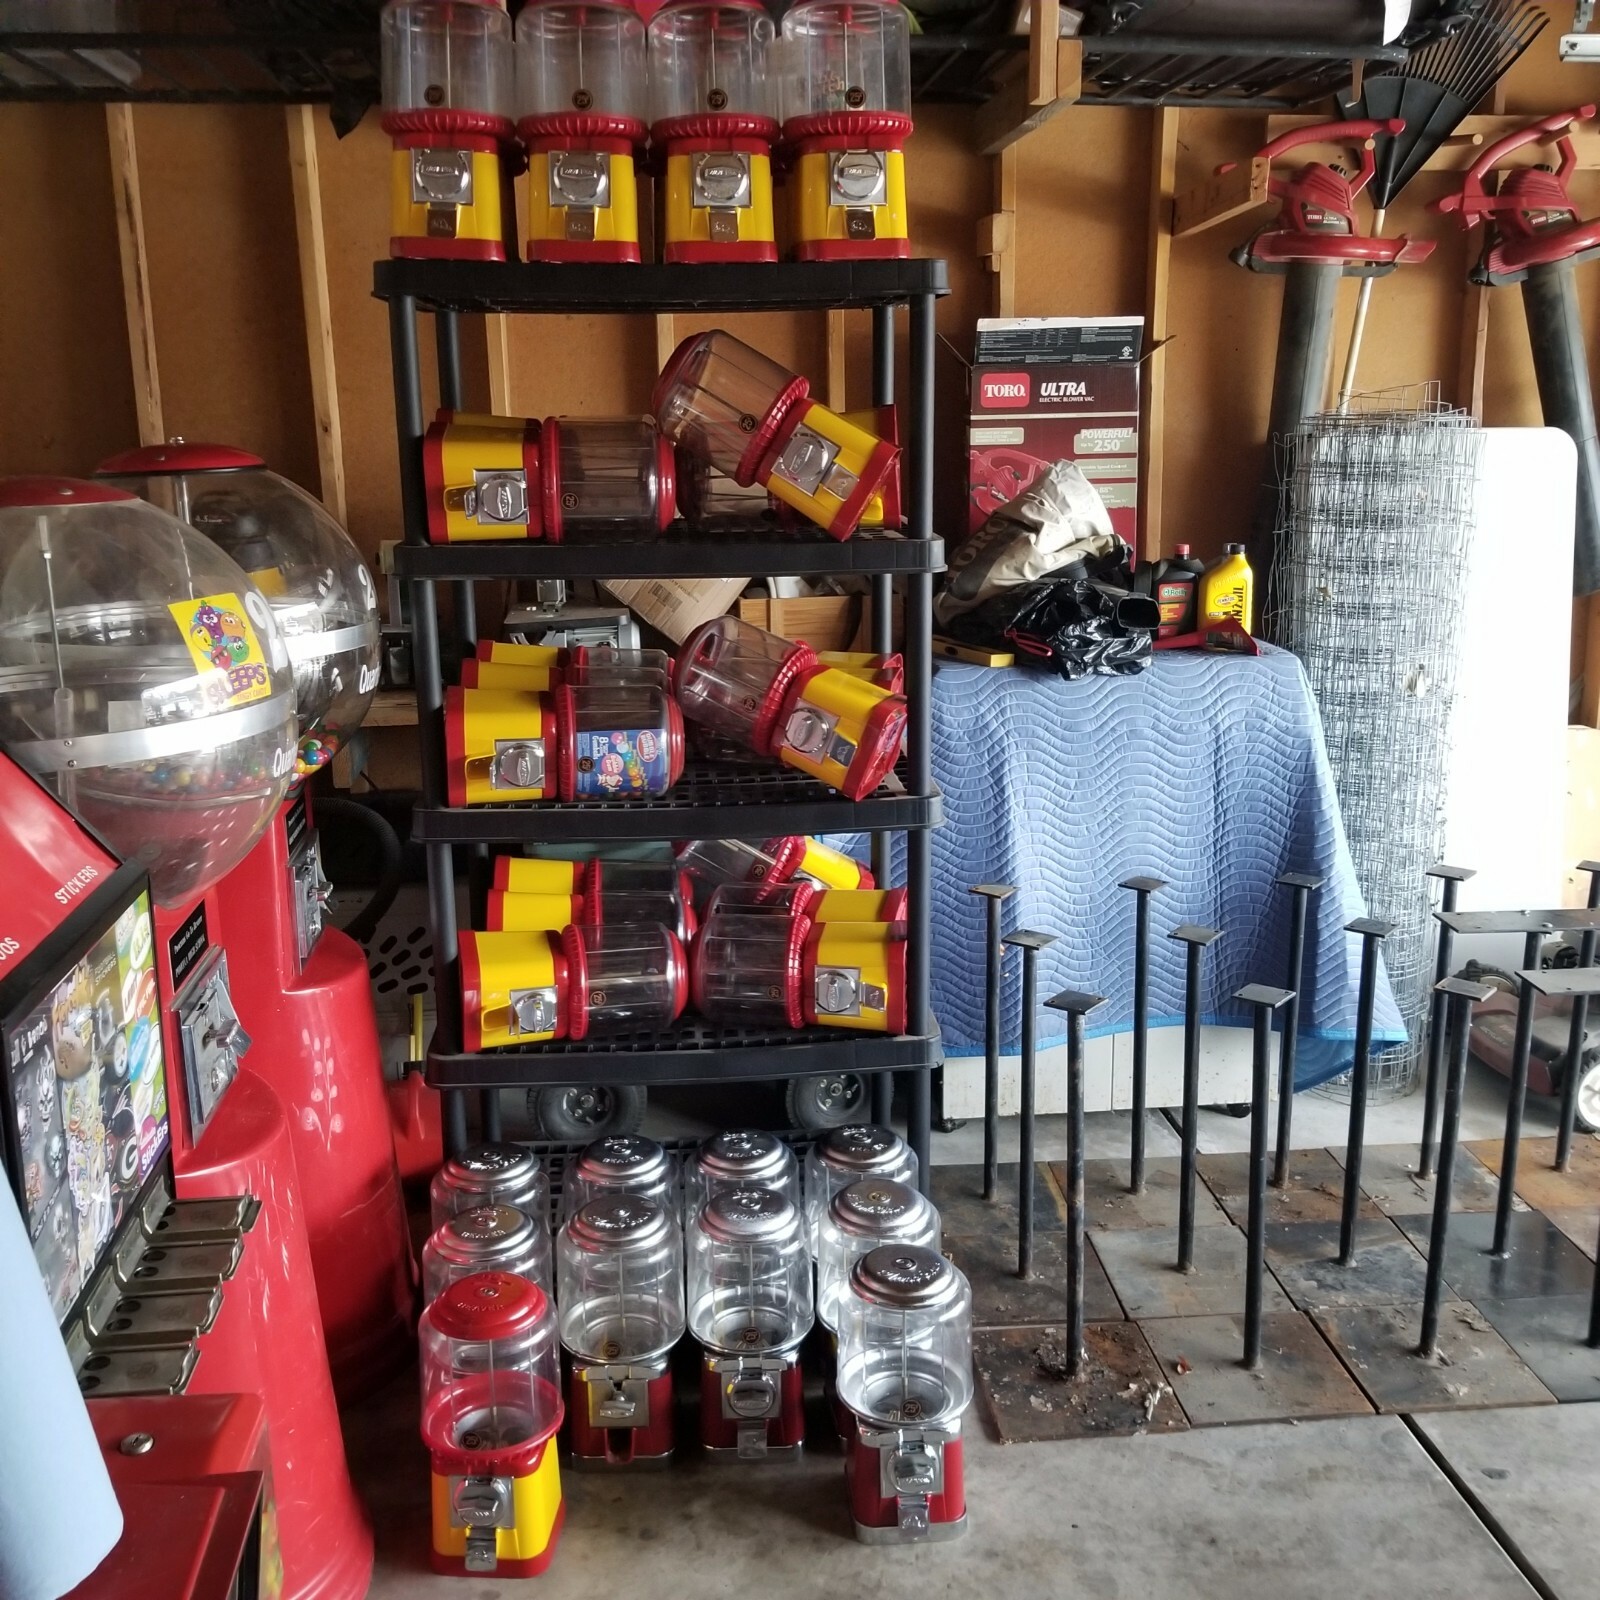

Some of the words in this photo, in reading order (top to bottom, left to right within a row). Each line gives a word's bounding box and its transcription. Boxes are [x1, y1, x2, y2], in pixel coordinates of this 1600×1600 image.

[984, 384, 1026, 397] TORO
[1040, 382, 1087, 396] ULTRA
[1081, 428, 1133, 439] POWERFUL!
[1093, 439, 1120, 452] 250
[54, 865, 99, 905] STICKERS
